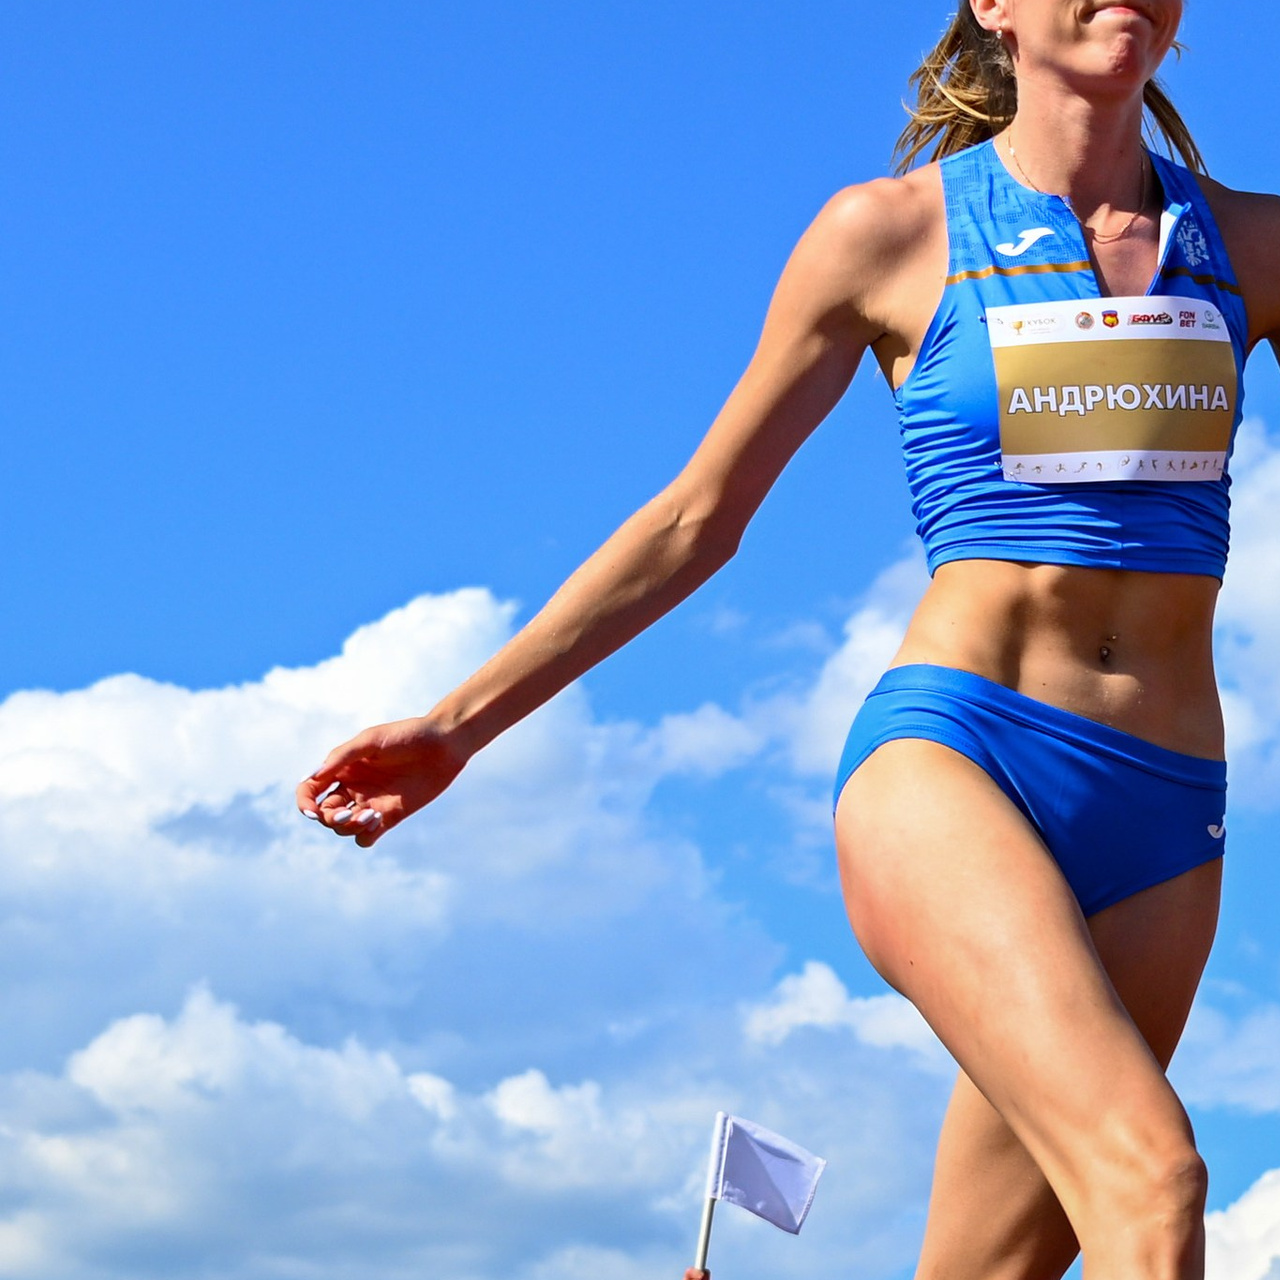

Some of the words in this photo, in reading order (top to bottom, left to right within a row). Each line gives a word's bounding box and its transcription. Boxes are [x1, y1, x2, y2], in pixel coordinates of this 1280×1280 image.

[1179, 310, 1196, 319] FON
[1179, 320, 1196, 328] BET
[1007, 383, 1230, 417] АНДРЮХИНА
